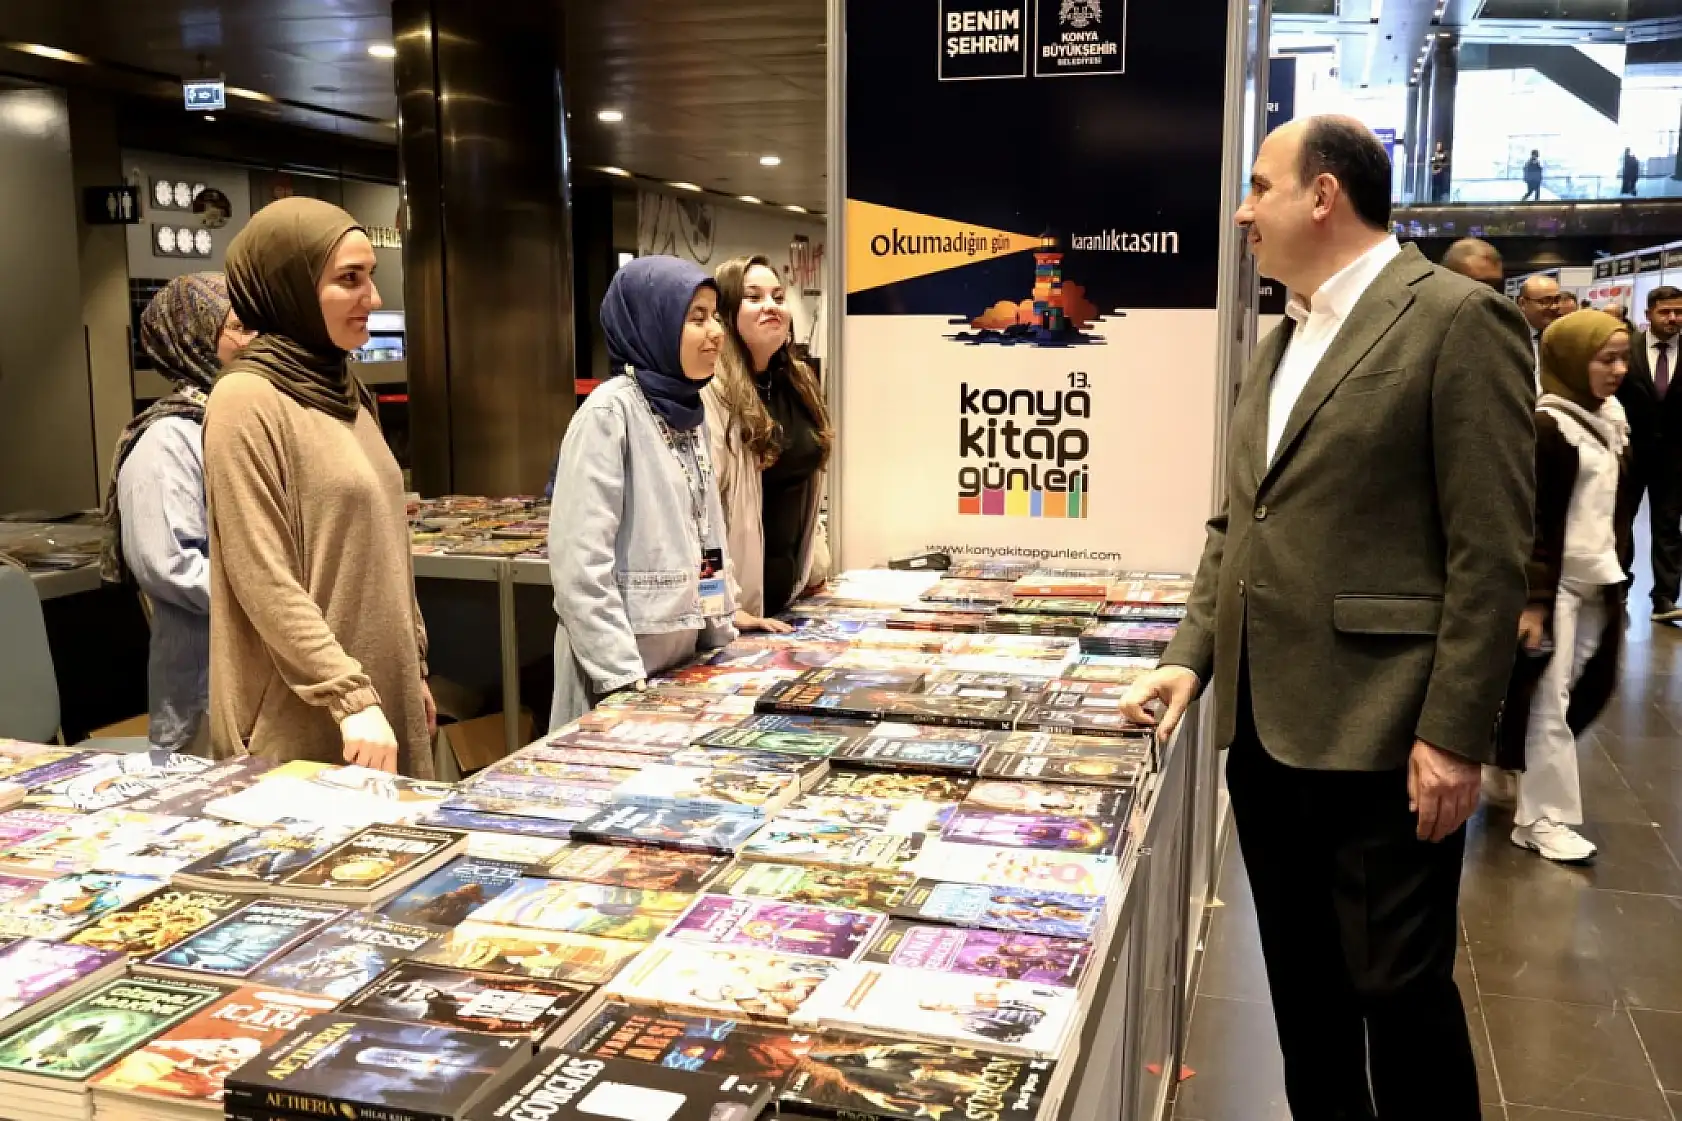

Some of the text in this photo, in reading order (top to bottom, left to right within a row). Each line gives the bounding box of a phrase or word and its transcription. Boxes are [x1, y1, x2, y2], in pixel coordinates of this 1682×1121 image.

[947, 9, 1020, 32] BENİM
[947, 34, 1020, 58] ŞEHRİM
[1061, 31, 1099, 42] KONYA
[1042, 41, 1118, 58] BÜYÜKŞEHİR
[871, 227, 1180, 256] okumadığın gün karanlıktasın
[1067, 371, 1092, 388] 13.
[960, 382, 1091, 426] konya
[959, 417, 1090, 468] kitap
[958, 462, 1089, 498] günleri
